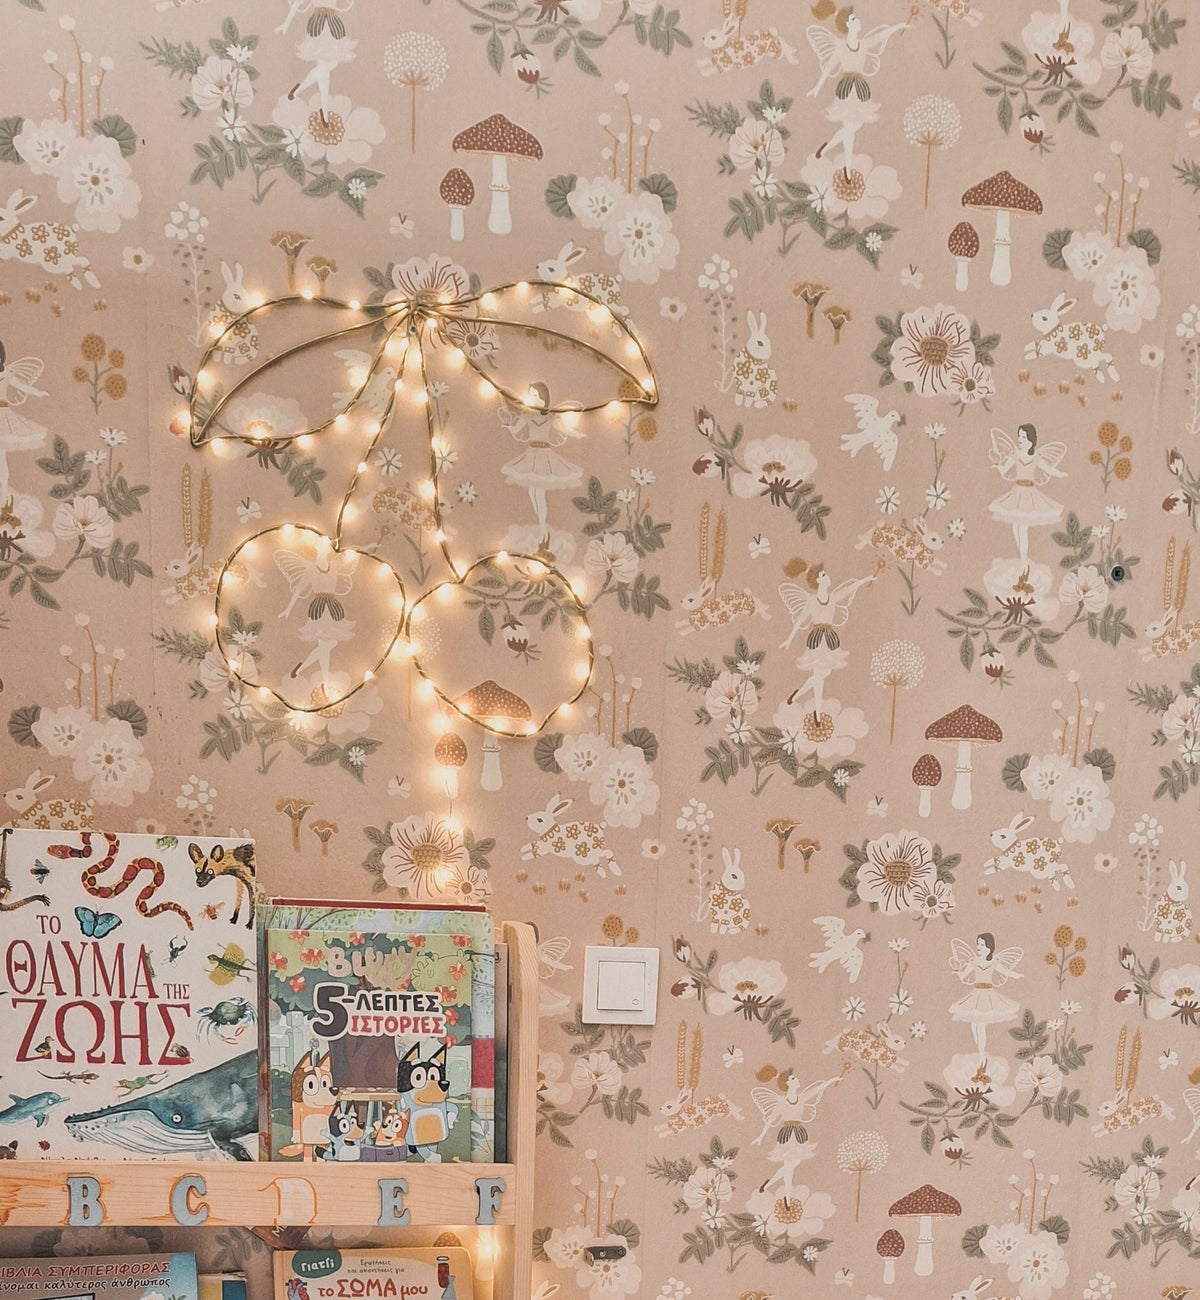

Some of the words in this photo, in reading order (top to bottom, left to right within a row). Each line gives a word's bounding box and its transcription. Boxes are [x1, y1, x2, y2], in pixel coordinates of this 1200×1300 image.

[36, 914, 62, 934] ΤΟ
[5, 939, 159, 999] ΘΑΥΜΑ
[162, 983, 190, 999] ΤΗΣ
[11, 998, 192, 1065] ΖΩΗΣ
[350, 1014, 444, 1035] ΙΣΤΟΡΙΕΣ
[66, 1176, 104, 1226] B
[171, 1175, 209, 1226] C
[377, 1178, 411, 1226] E
[475, 1177, 506, 1225] F
[1, 1267, 42, 1278] ΙΒΛΙΑ
[48, 1262, 170, 1277] ΣΥΜΠΕΡΙΦΟΡΑΣ
[44, 1280, 106, 1291] καλύτερος
[111, 1278, 171, 1289] άνθρωπος
[317, 1287, 335, 1297] το
[336, 1278, 397, 1298] ΣΩΜΑ
[400, 1285, 428, 1300] μου
